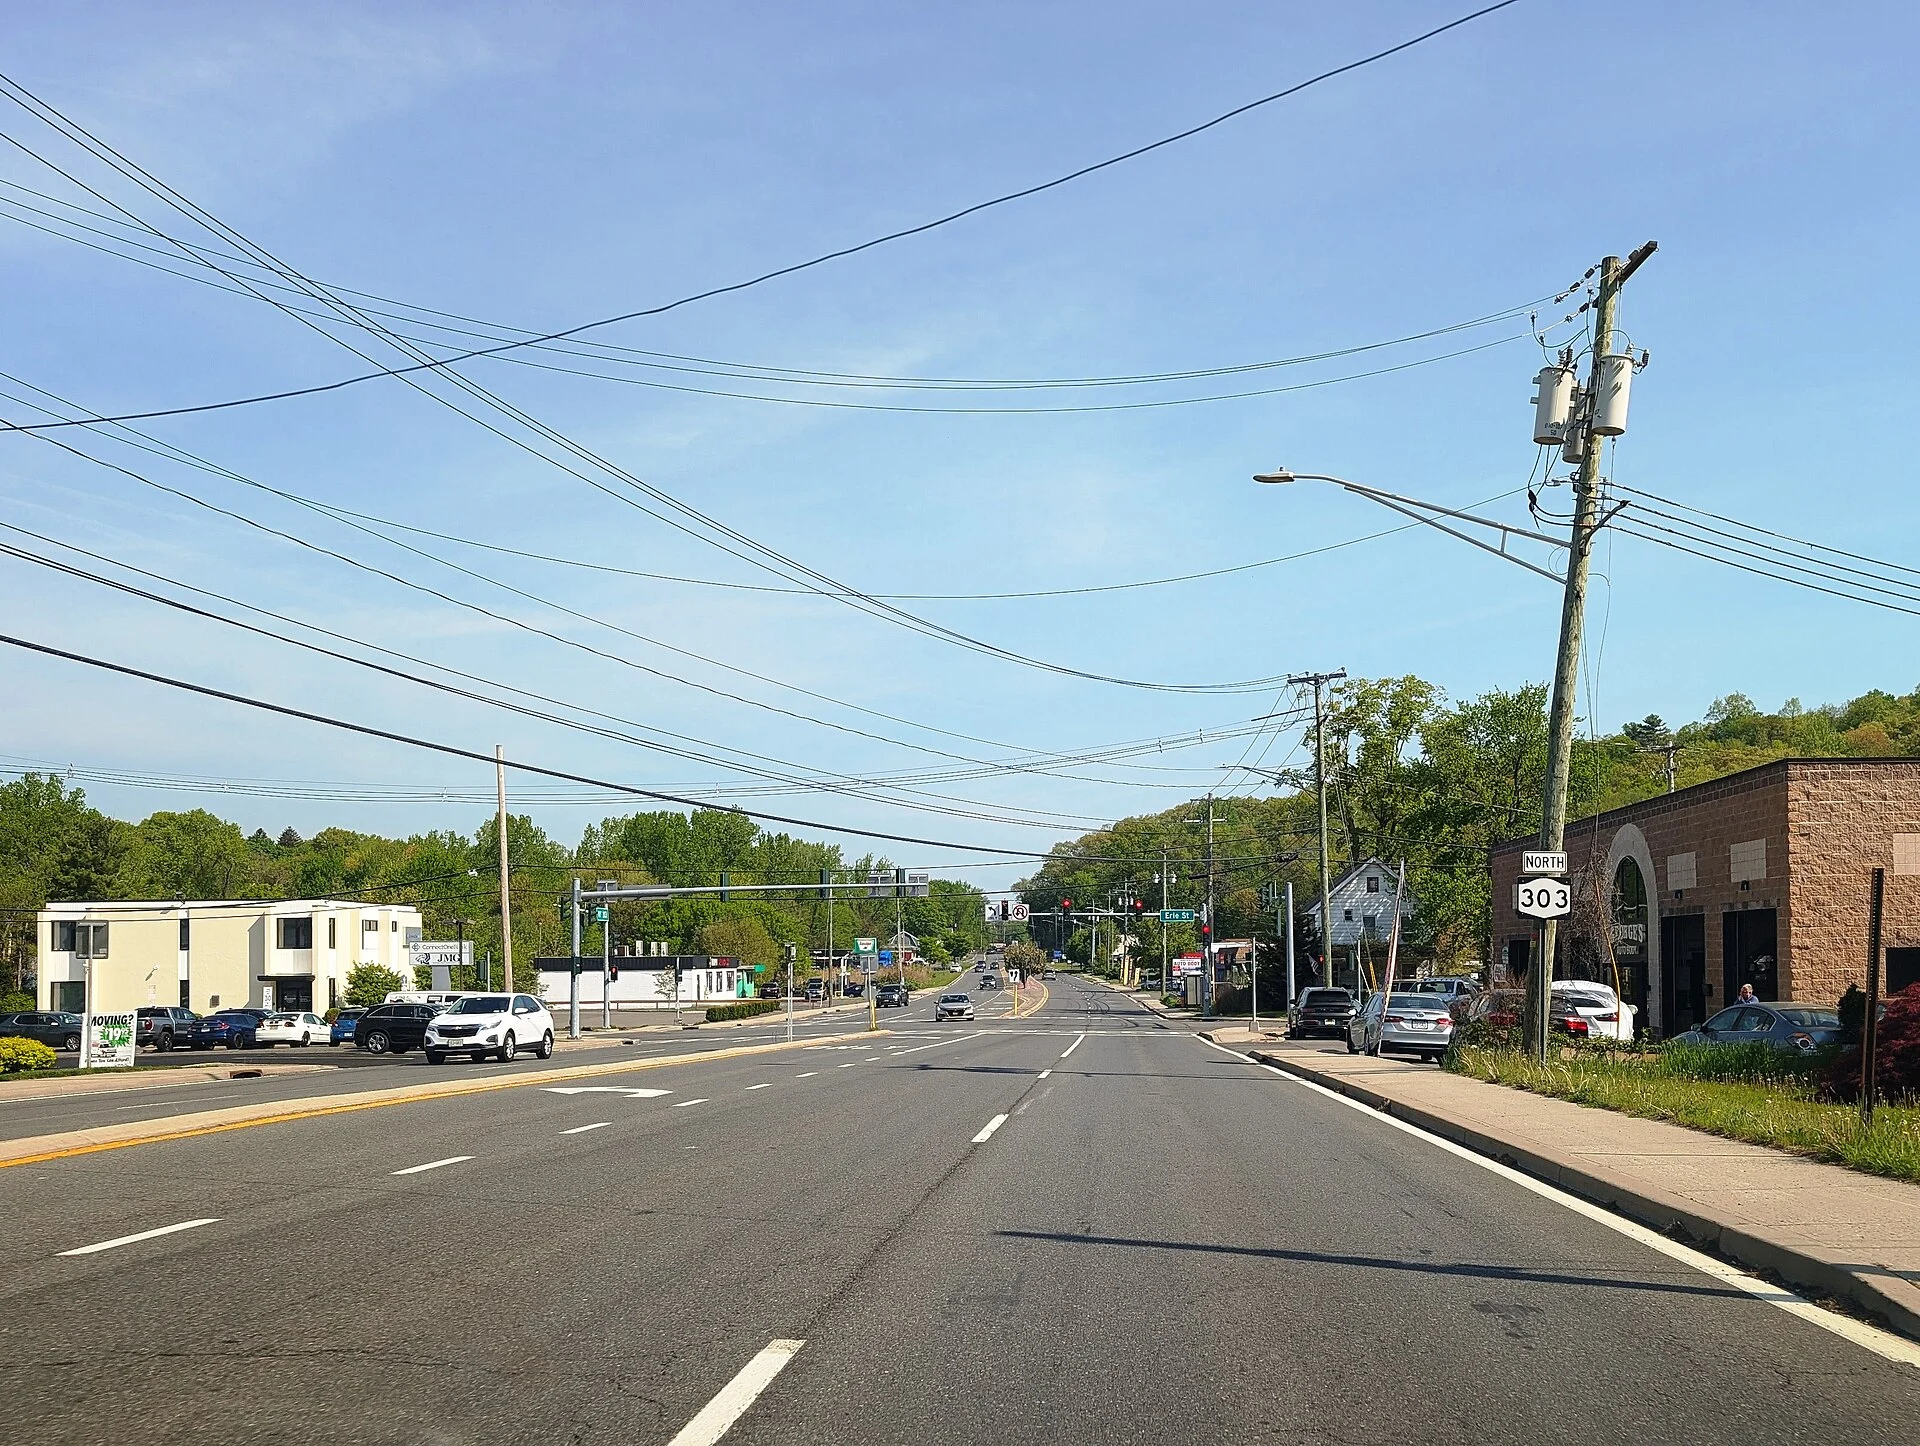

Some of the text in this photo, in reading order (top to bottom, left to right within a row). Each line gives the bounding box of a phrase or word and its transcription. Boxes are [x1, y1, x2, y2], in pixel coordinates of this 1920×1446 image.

[1525, 855, 1564, 869] NORTH
[1520, 888, 1568, 909] 303
[1165, 911, 1190, 920] Erie St
[437, 953, 462, 963] JMG
[87, 1014, 134, 1027] MOVING?
